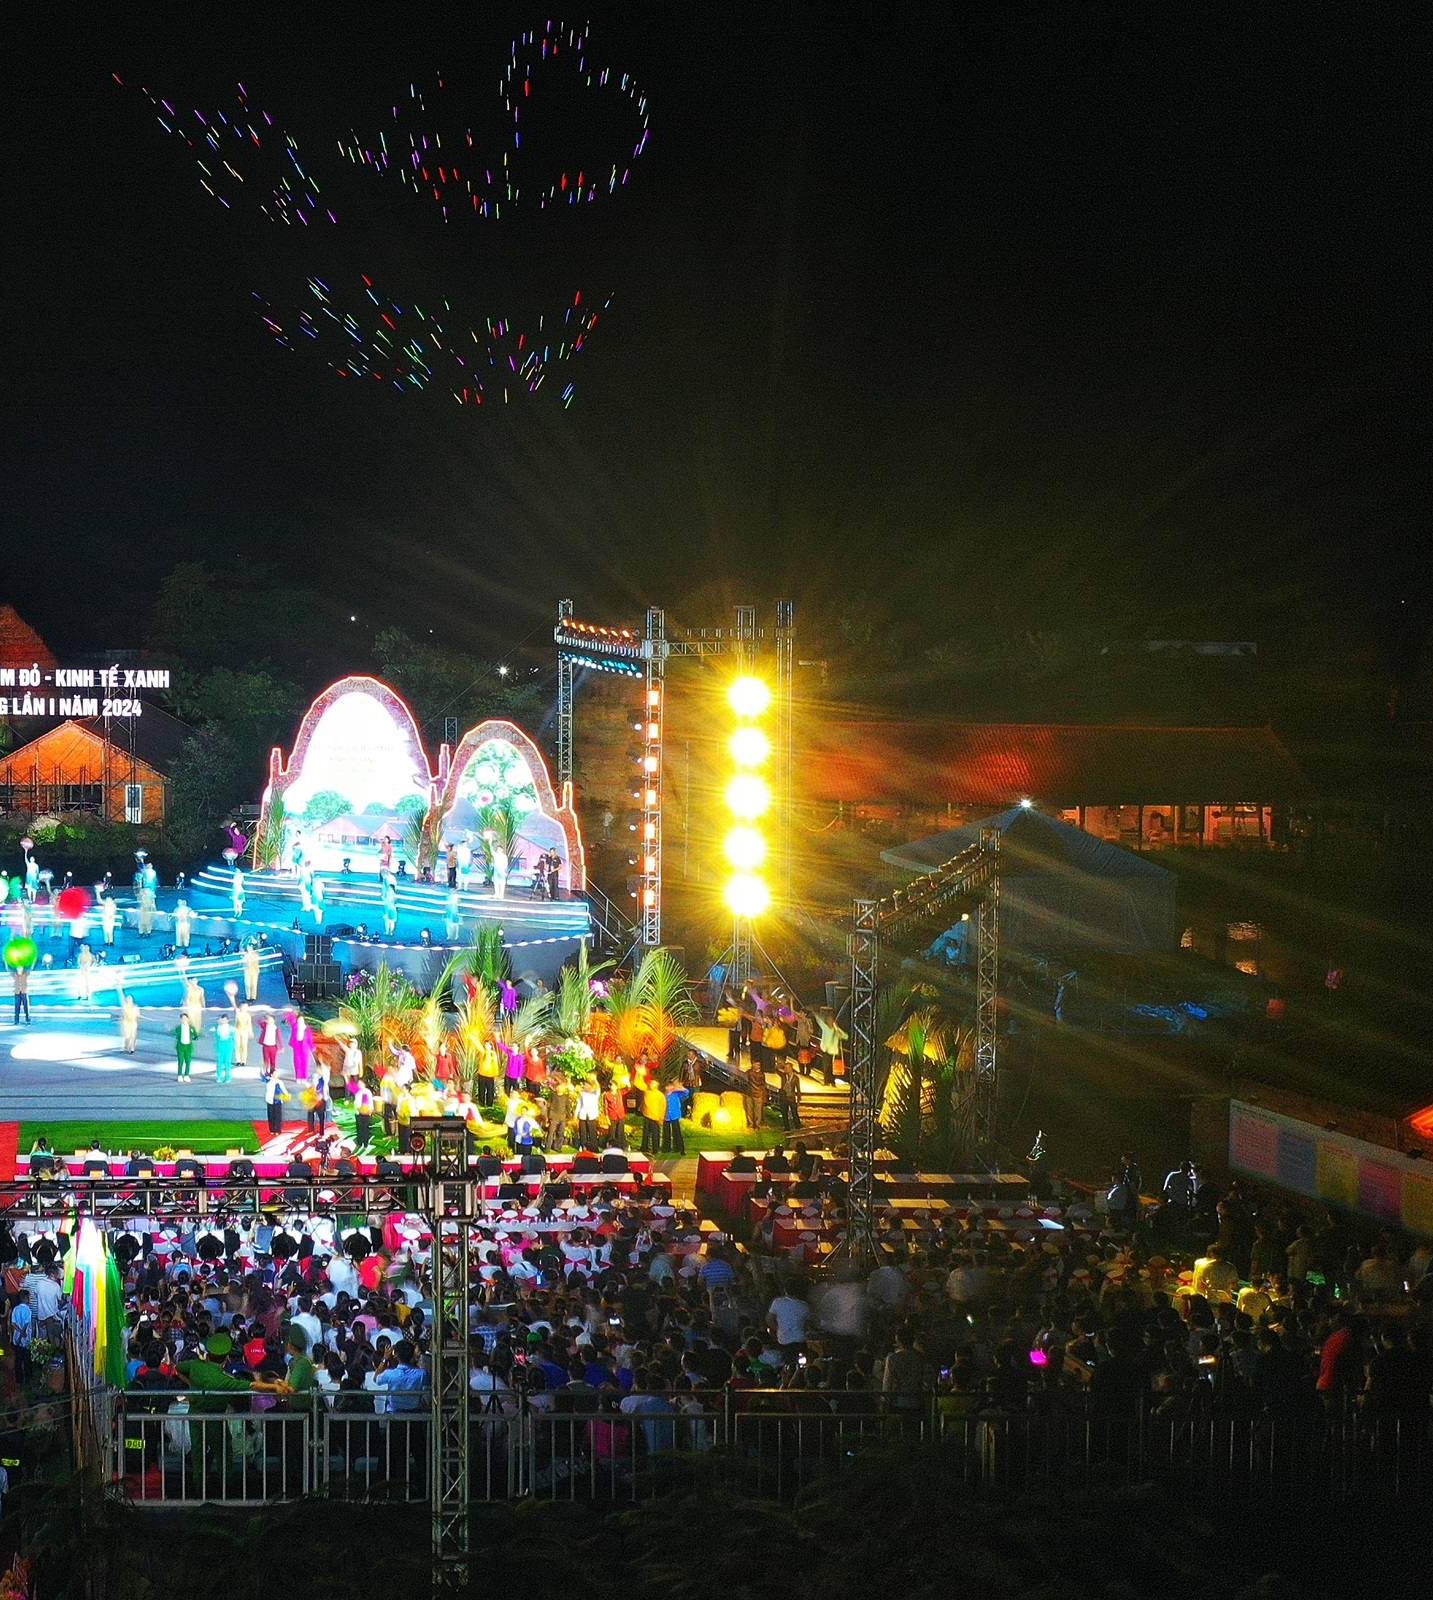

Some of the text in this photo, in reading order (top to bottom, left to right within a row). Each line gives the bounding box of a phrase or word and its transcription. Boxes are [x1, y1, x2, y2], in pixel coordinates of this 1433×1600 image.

[18, 662, 41, 687] ĐỎ
[55, 669, 94, 687] KINH
[99, 664, 119, 688] TẾ
[123, 670, 170, 688] XANH
[12, 691, 46, 716] LẦN
[49, 697, 56, 716] I
[59, 695, 98, 716] NĂM
[102, 698, 143, 717] 2024
